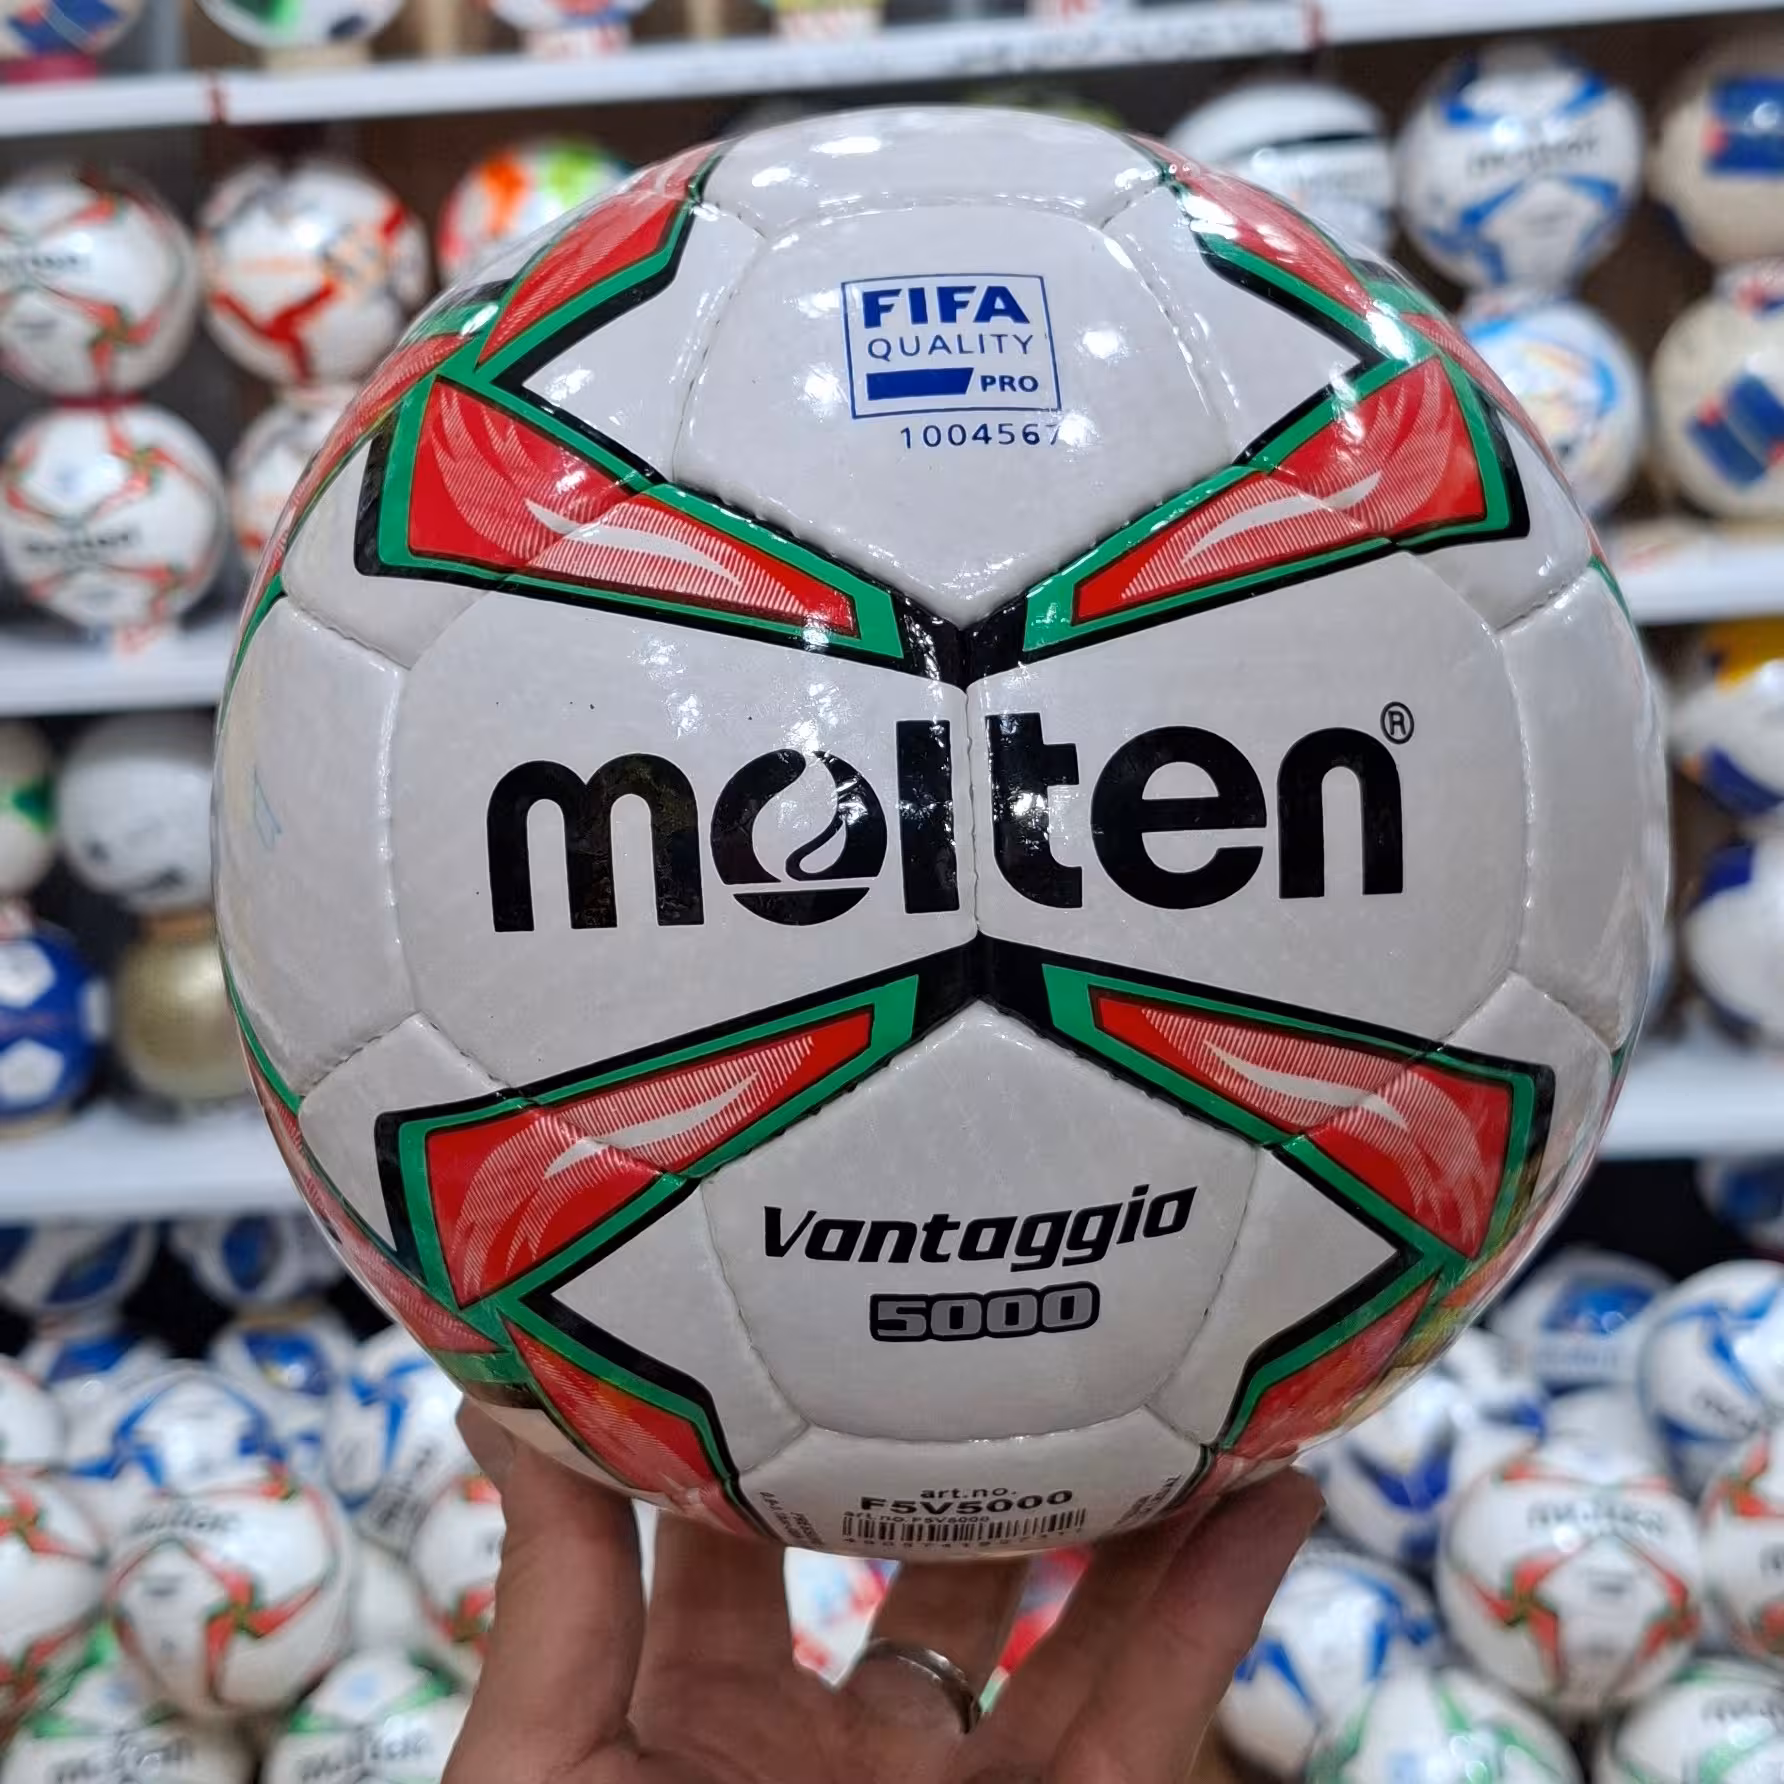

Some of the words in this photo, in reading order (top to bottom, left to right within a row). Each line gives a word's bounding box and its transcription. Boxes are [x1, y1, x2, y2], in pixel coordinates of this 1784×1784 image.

[862, 286, 1031, 329] FIFA
[867, 333, 1034, 362] QUALITY
[980, 374, 1039, 392] PRO
[486, 712, 1404, 933] molten
[763, 1183, 1199, 1273] Vantaggio
[869, 1281, 1101, 1342] 5000
[860, 1489, 1073, 1515] F5V5000
